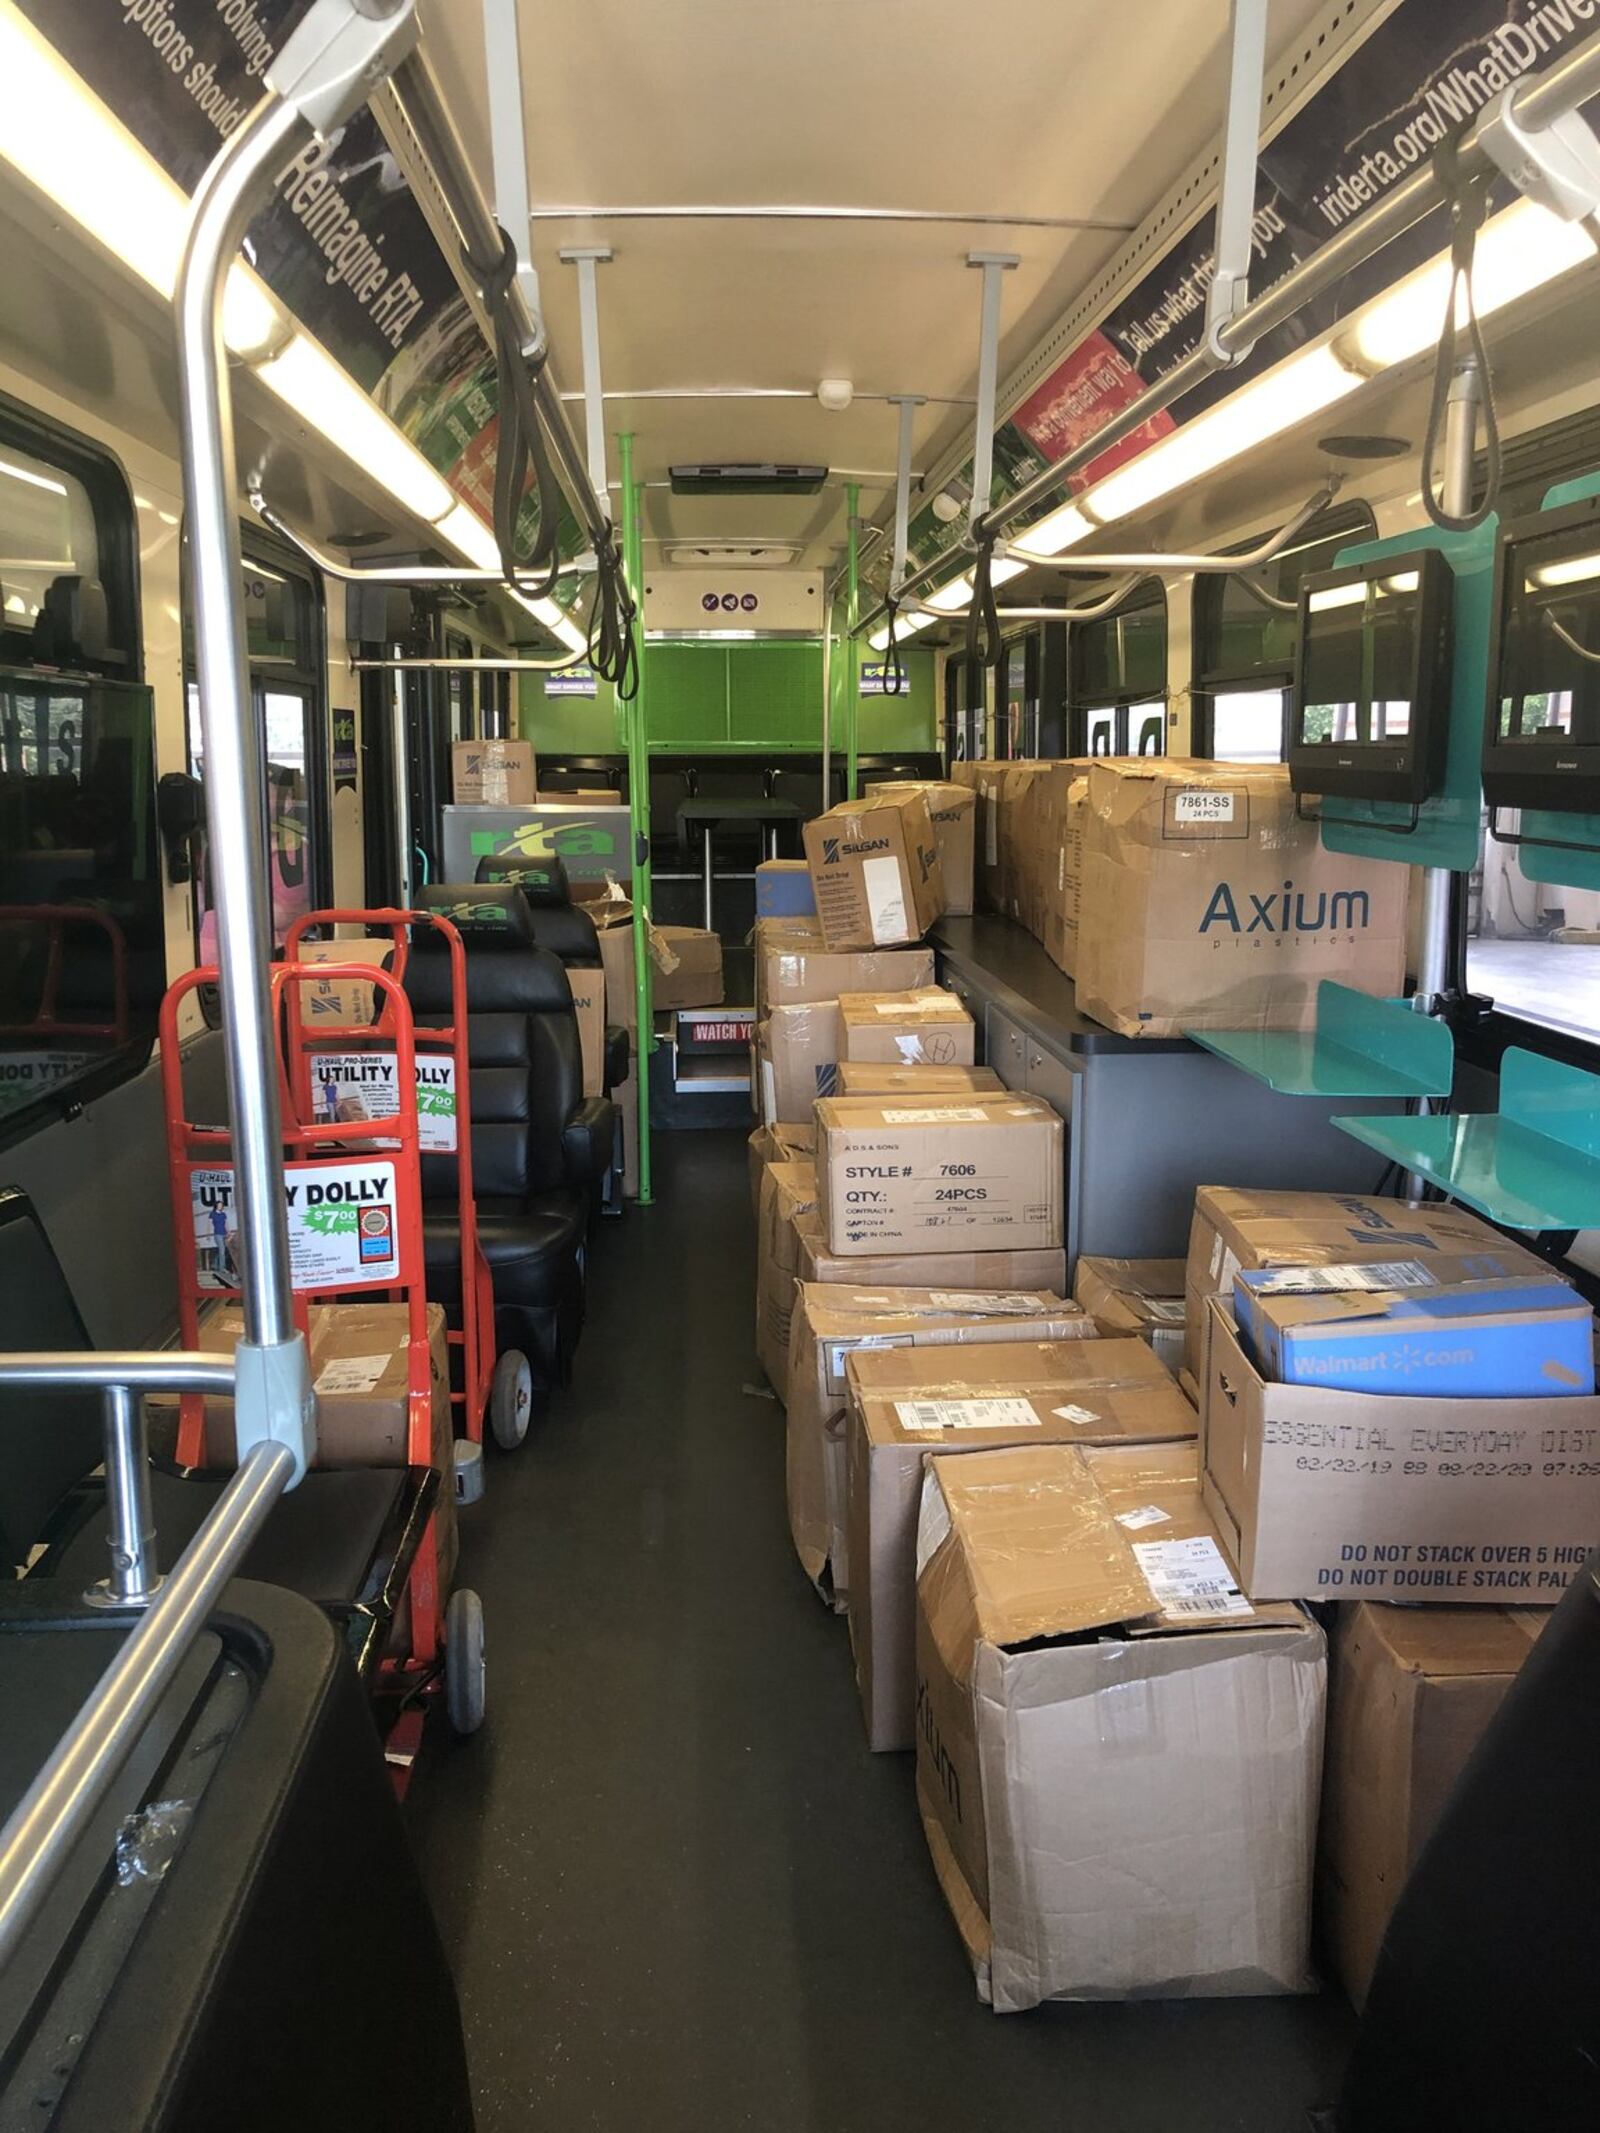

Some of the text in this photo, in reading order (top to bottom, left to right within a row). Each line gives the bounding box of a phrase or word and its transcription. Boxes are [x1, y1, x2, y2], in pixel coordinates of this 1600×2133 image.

[184, 62, 247, 138] should
[274, 138, 388, 304] Reimagine
[1160, 277, 1205, 324] what
[1106, 353, 1132, 376] to
[1091, 363, 1125, 392] way
[1181, 797, 1229, 808] 7861-SS
[1203, 809, 1219, 818] PCS
[470, 822, 615, 857] rta
[842, 838, 889, 855] SILGAN
[488, 869, 550, 885] rta
[1198, 880, 1369, 933] Axium
[696, 1024, 736, 1040] WATCH
[318, 1066, 450, 1084] UTILITY OLLY
[845, 1166, 899, 1178] STYLE
[940, 1164, 976, 1177] 7606
[306, 1178, 389, 1206] DOLLY
[846, 1188, 987, 1203] QTY.: 24PCS
[1293, 1348, 1474, 1377] Walmart com
[1264, 1420, 1395, 1451] ESSENTIAL
[1410, 1429, 1527, 1454] EVERYDAY
[1296, 1456, 1393, 1475] 02/22/19
[1341, 1545, 1369, 1562] DO
[1373, 1545, 1412, 1562] NOT
[1416, 1546, 1474, 1562] STACK
[1481, 1546, 1531, 1563] OVER
[1537, 1547, 1547, 1563] 5
[1317, 1569, 1344, 1585] DO
[1350, 1569, 1388, 1585] NOT
[1393, 1569, 1467, 1586] DOUBLE
[1473, 1570, 1531, 1587] STACK
[917, 1677, 962, 1823] xium
